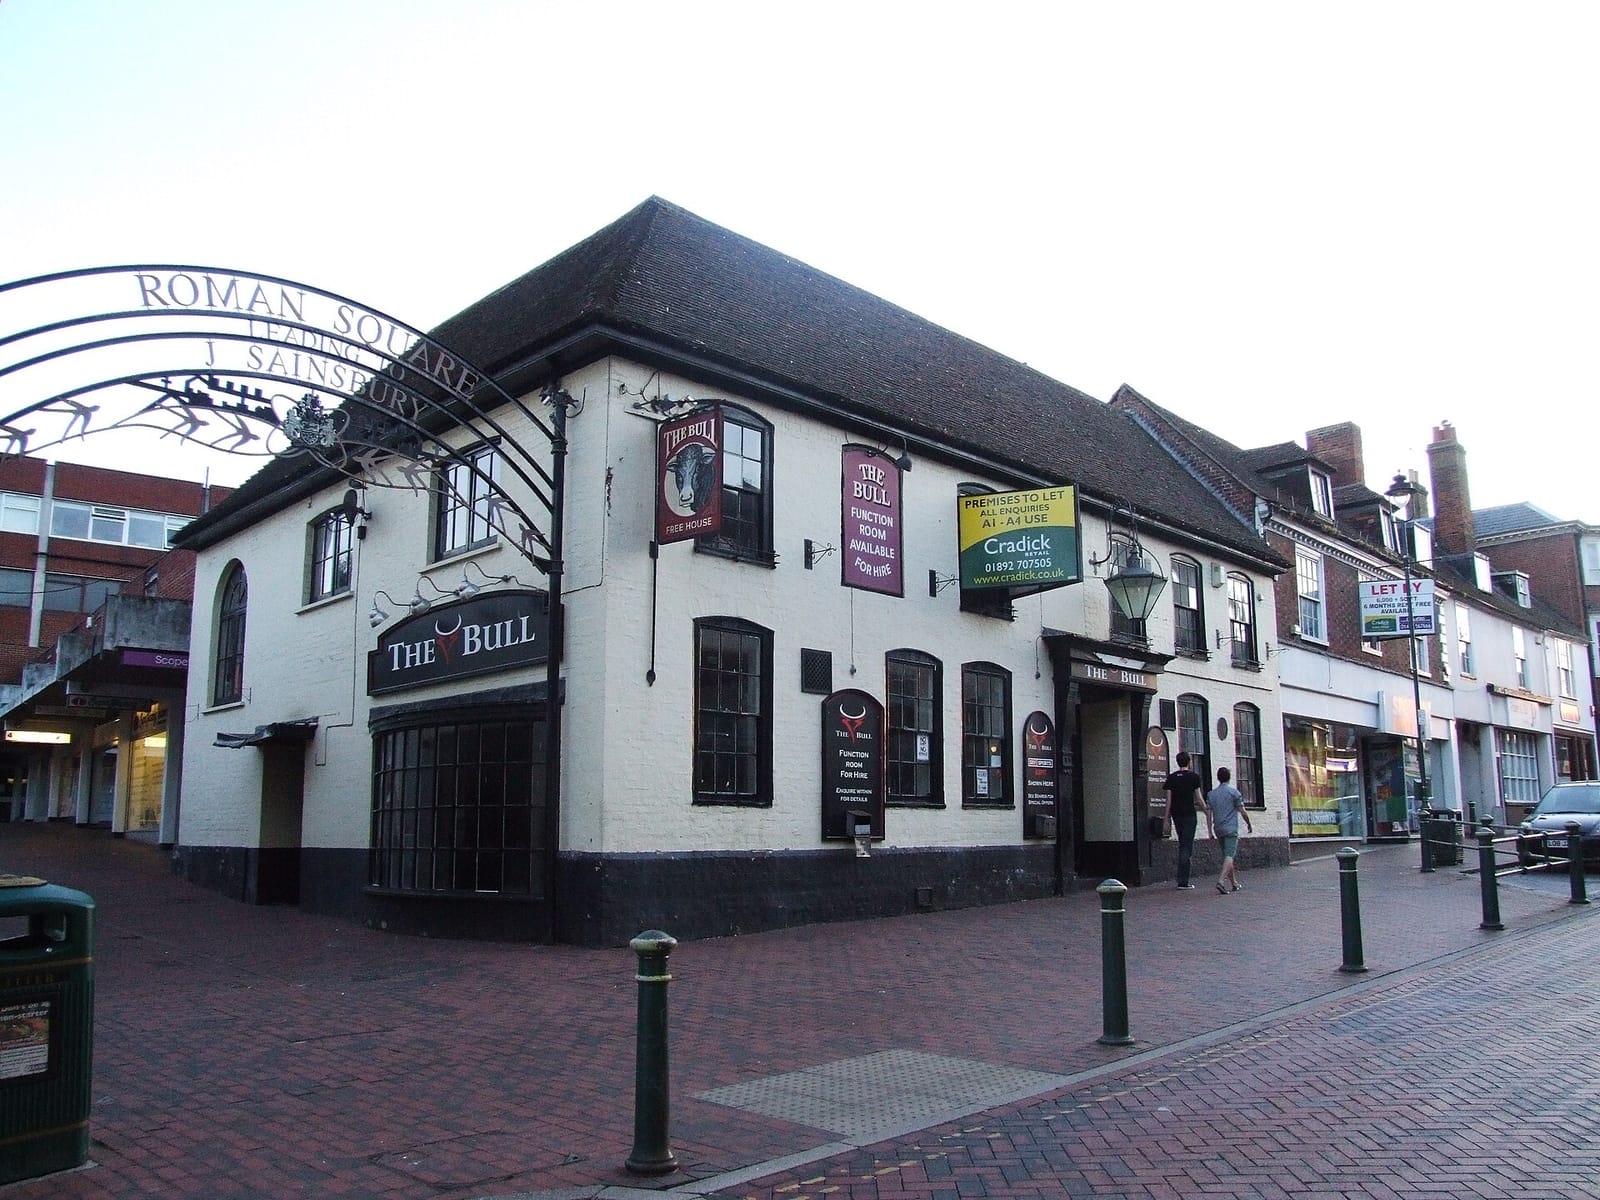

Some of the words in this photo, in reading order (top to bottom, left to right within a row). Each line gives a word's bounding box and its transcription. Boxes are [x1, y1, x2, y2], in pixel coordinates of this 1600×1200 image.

[133, 274, 307, 321] ROMAN
[333, 304, 480, 399] SQUARE
[249, 321, 360, 361] LEADING
[205, 341, 215, 367] J
[247, 345, 428, 422] SAINSBURY
[664, 426, 687, 459] THE
[858, 463, 886, 487] THE
[853, 480, 891, 507] BULL
[965, 495, 1020, 509] PREMISES
[1023, 493, 1039, 504] TO
[1043, 490, 1065, 501] LET
[851, 506, 894, 528] FUNCTION
[980, 509, 998, 518] ALL
[1000, 504, 1050, 515] ENQUIRIES
[1006, 516, 1021, 527] A4
[1024, 514, 1048, 524] USE
[665, 523, 684, 535] FREE
[685, 517, 712, 531] HOUSE
[859, 524, 886, 541] ROOM
[849, 539, 895, 559] AVAILABLE
[984, 534, 1051, 555] Cradick
[854, 556, 872, 576] FOR
[872, 563, 892, 578] HIRE
[985, 562, 1014, 573] 01892
[1017, 558, 1052, 570] 707505
[974, 567, 1065, 585] www.cradick.co.uk
[1371, 584, 1398, 596] LET
[388, 638, 436, 672] THE
[462, 615, 536, 656] BULL
[154, 655, 188, 667] Scope
[1084, 664, 1108, 680] THE
[1121, 670, 1147, 686] BULL
[856, 732, 872, 740] BULL
[839, 749, 869, 758] FUNCTION
[840, 770, 853, 778] FOR
[853, 771, 868, 779] HIRE
[845, 761, 863, 769] ROOM
